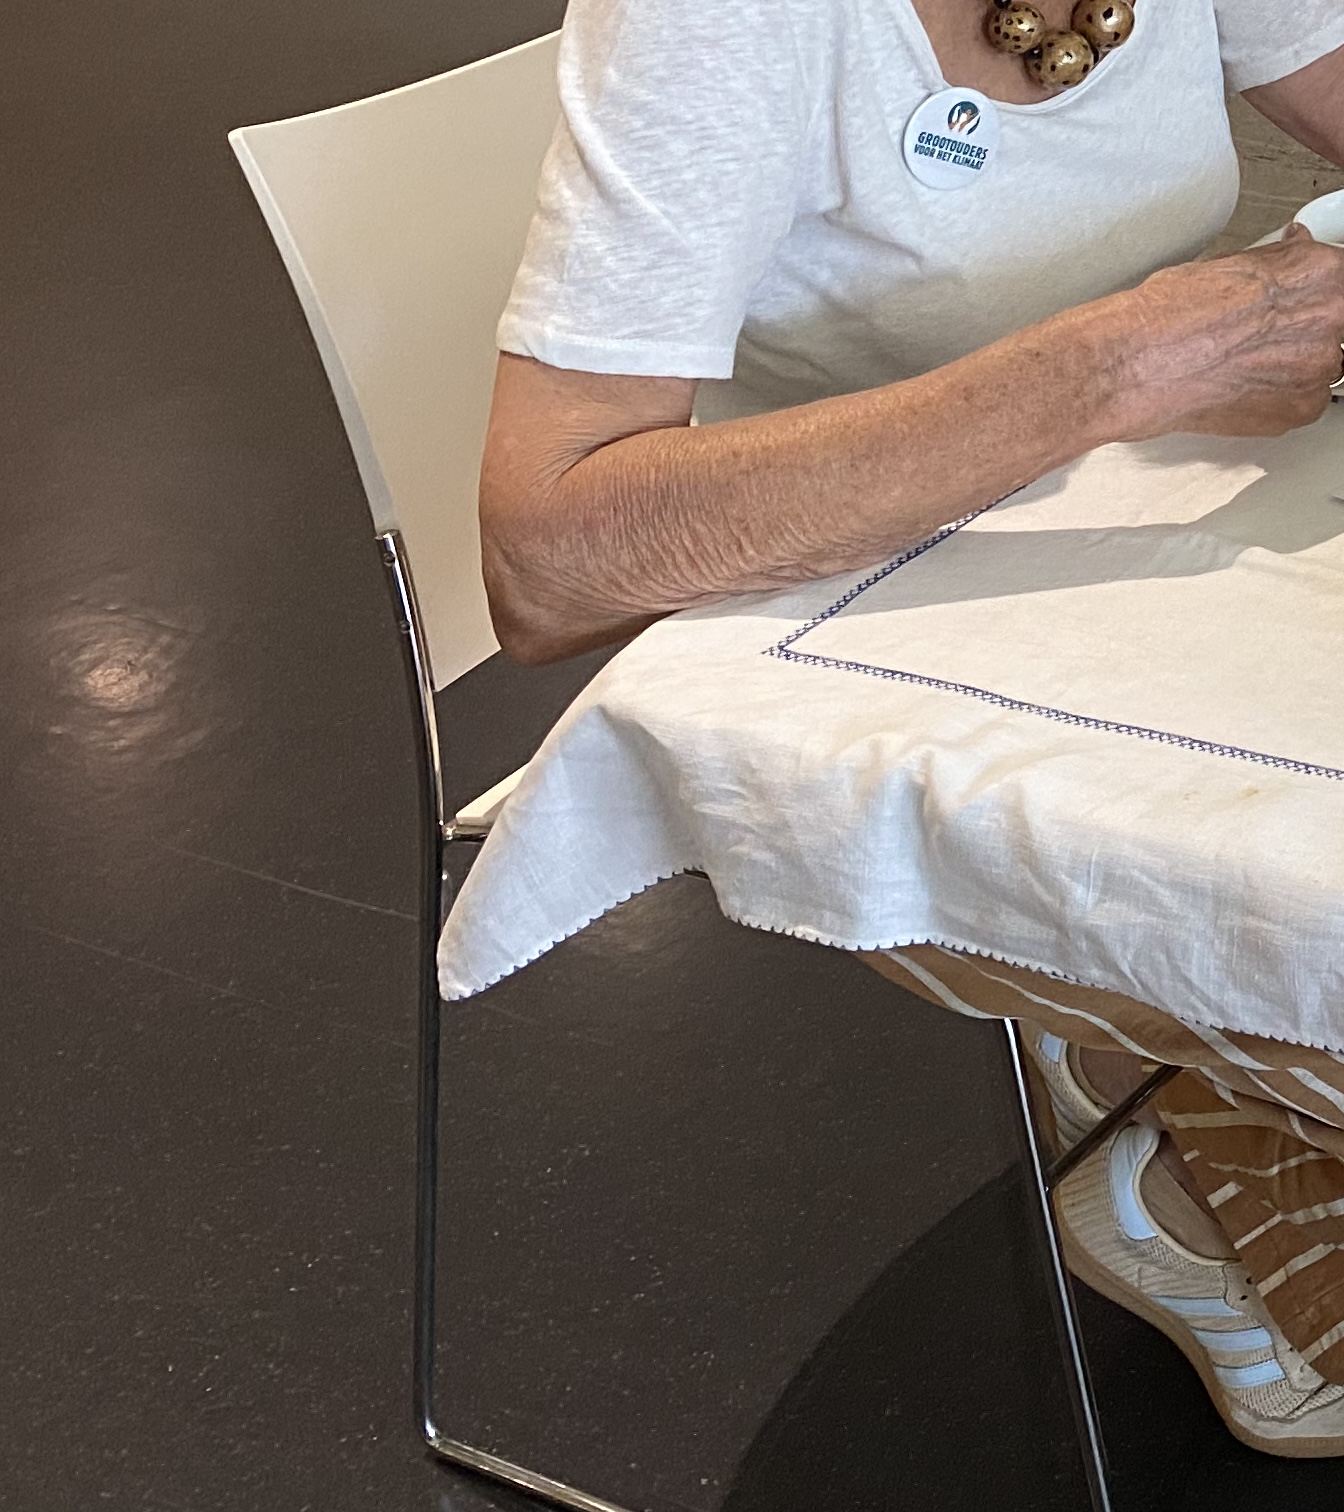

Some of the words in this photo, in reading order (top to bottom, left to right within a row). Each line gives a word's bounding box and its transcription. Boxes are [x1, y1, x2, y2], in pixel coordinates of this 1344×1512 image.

[914, 143, 936, 158] VOOR
[936, 149, 952, 163] HET
[952, 154, 984, 170] KLIMAAT
[917, 131, 989, 160] GROOTOUDERS
